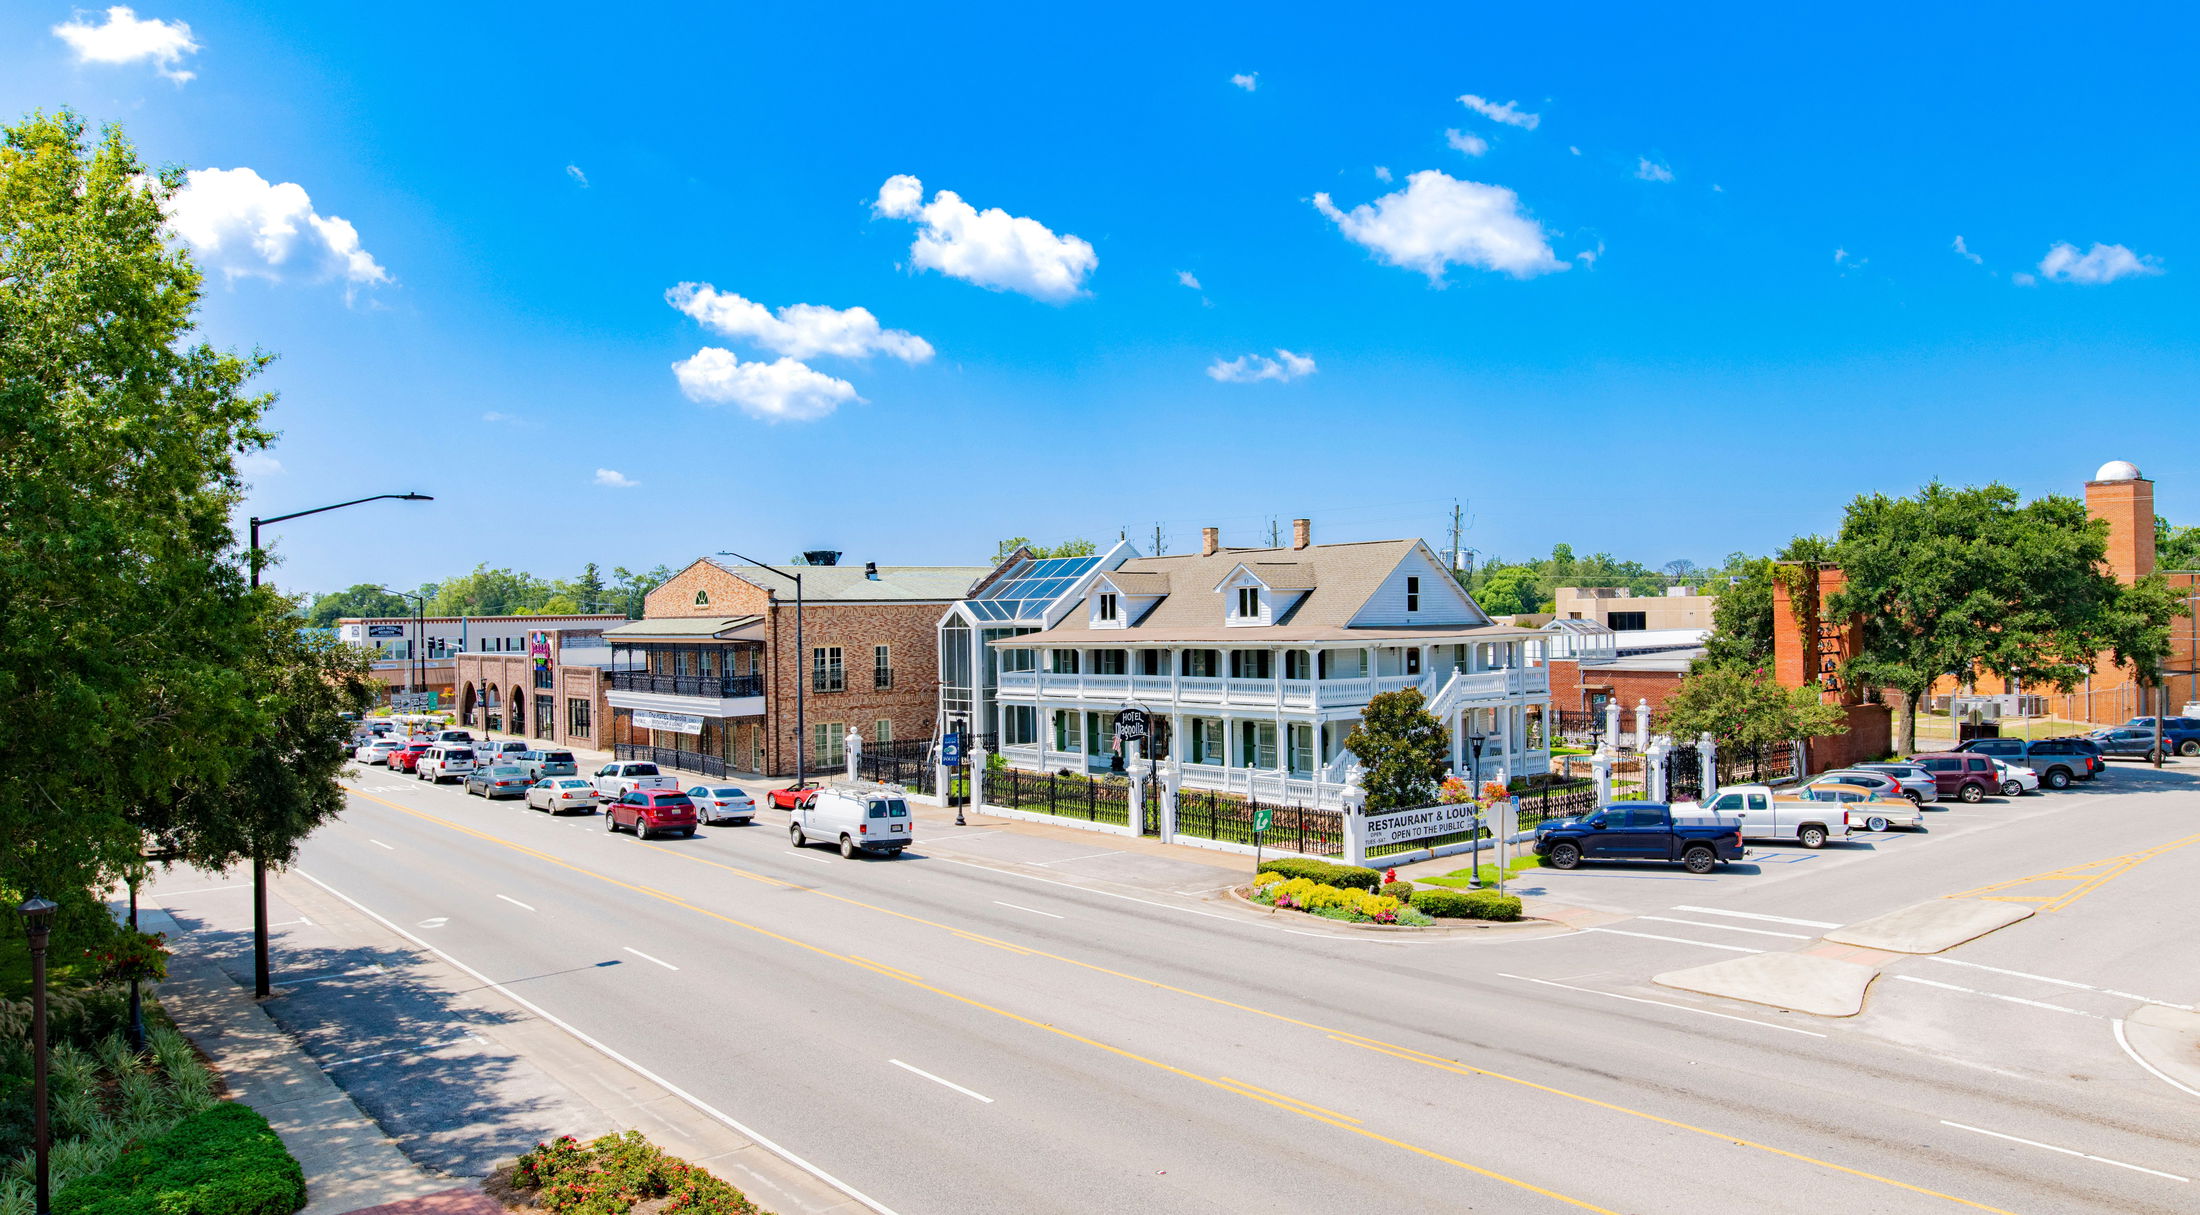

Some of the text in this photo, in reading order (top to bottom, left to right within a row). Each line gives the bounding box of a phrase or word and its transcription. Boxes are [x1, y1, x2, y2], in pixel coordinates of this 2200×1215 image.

[1122, 712, 1144, 724] HOTEL
[1115, 722, 1145, 740] Magnolia
[1368, 806, 1475, 832] RESTAURANT & LOUN
[1391, 829, 1411, 841] OPEN
[1413, 827, 1422, 836] TO
[1424, 825, 1438, 835] THE
[1439, 820, 1465, 833] PUBLIC
